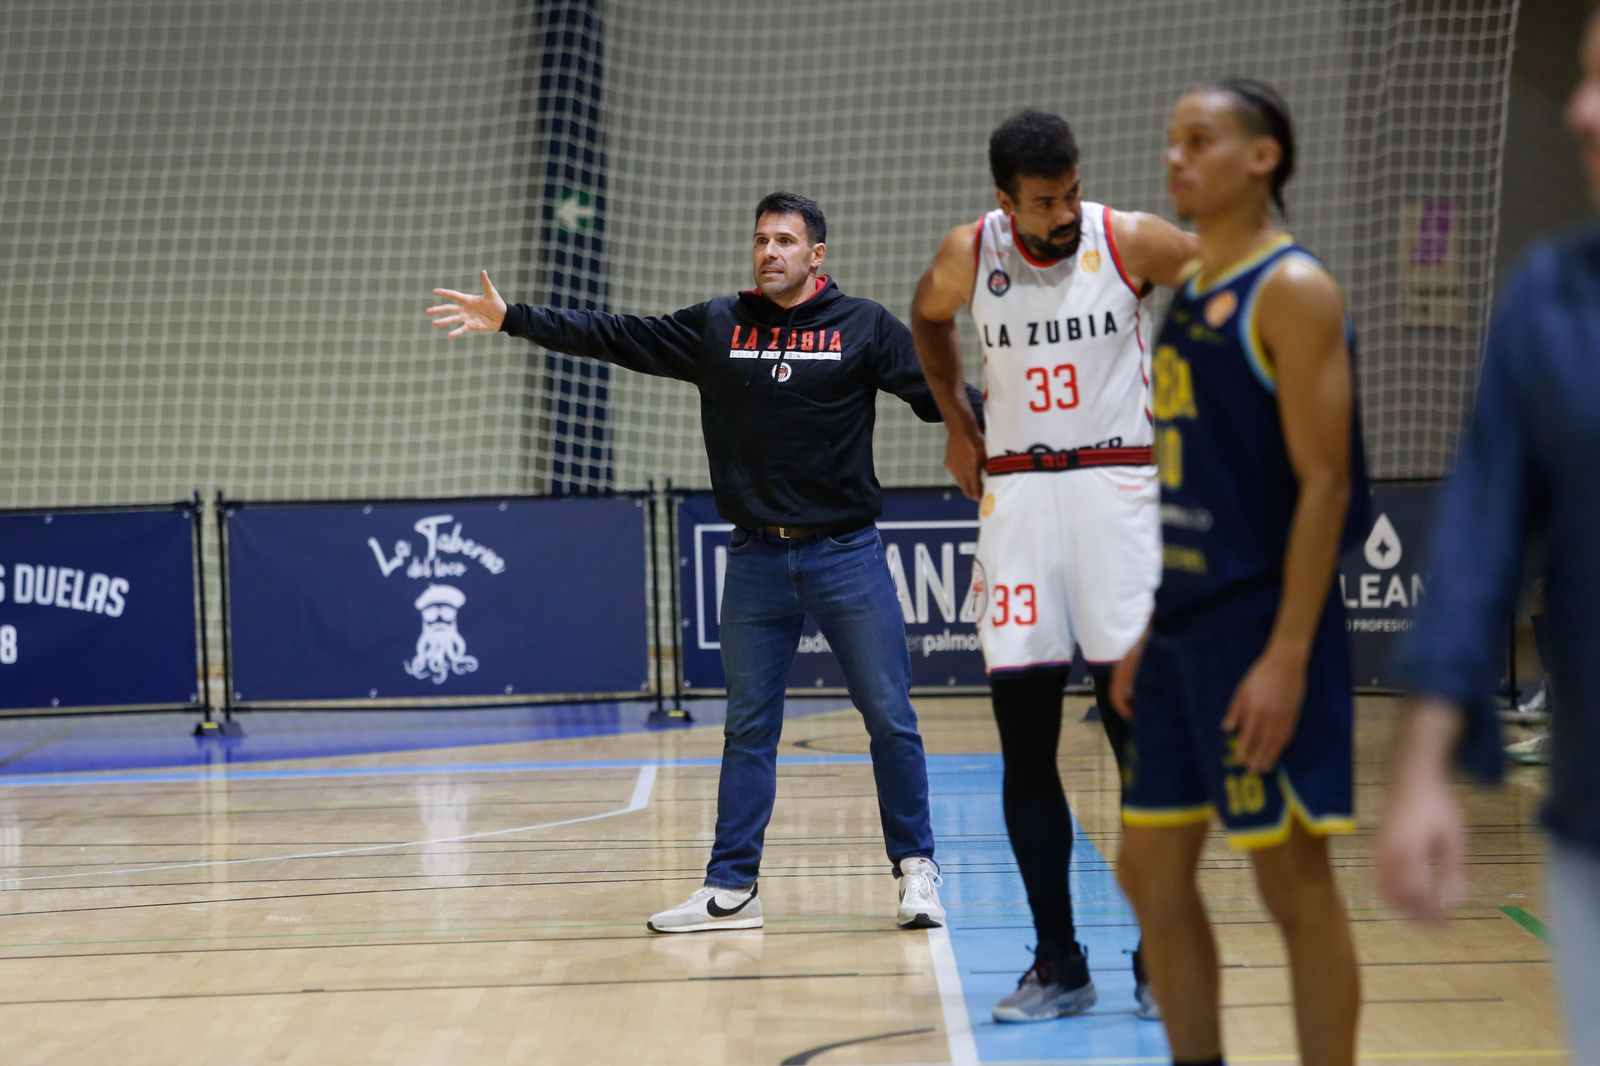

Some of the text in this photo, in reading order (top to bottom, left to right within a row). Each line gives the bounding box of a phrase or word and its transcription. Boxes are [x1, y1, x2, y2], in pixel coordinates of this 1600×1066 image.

[730, 324, 842, 352] LA ZUBIA
[984, 310, 1118, 347] LA ZUBIA
[1025, 362, 1081, 414] 33
[14, 562, 130, 618] DUELAS
[991, 583, 1038, 628] 33
[1338, 573, 1425, 609] LEAN
[1353, 617, 1417, 633] PROFESION
[1224, 773, 1266, 816] 10
